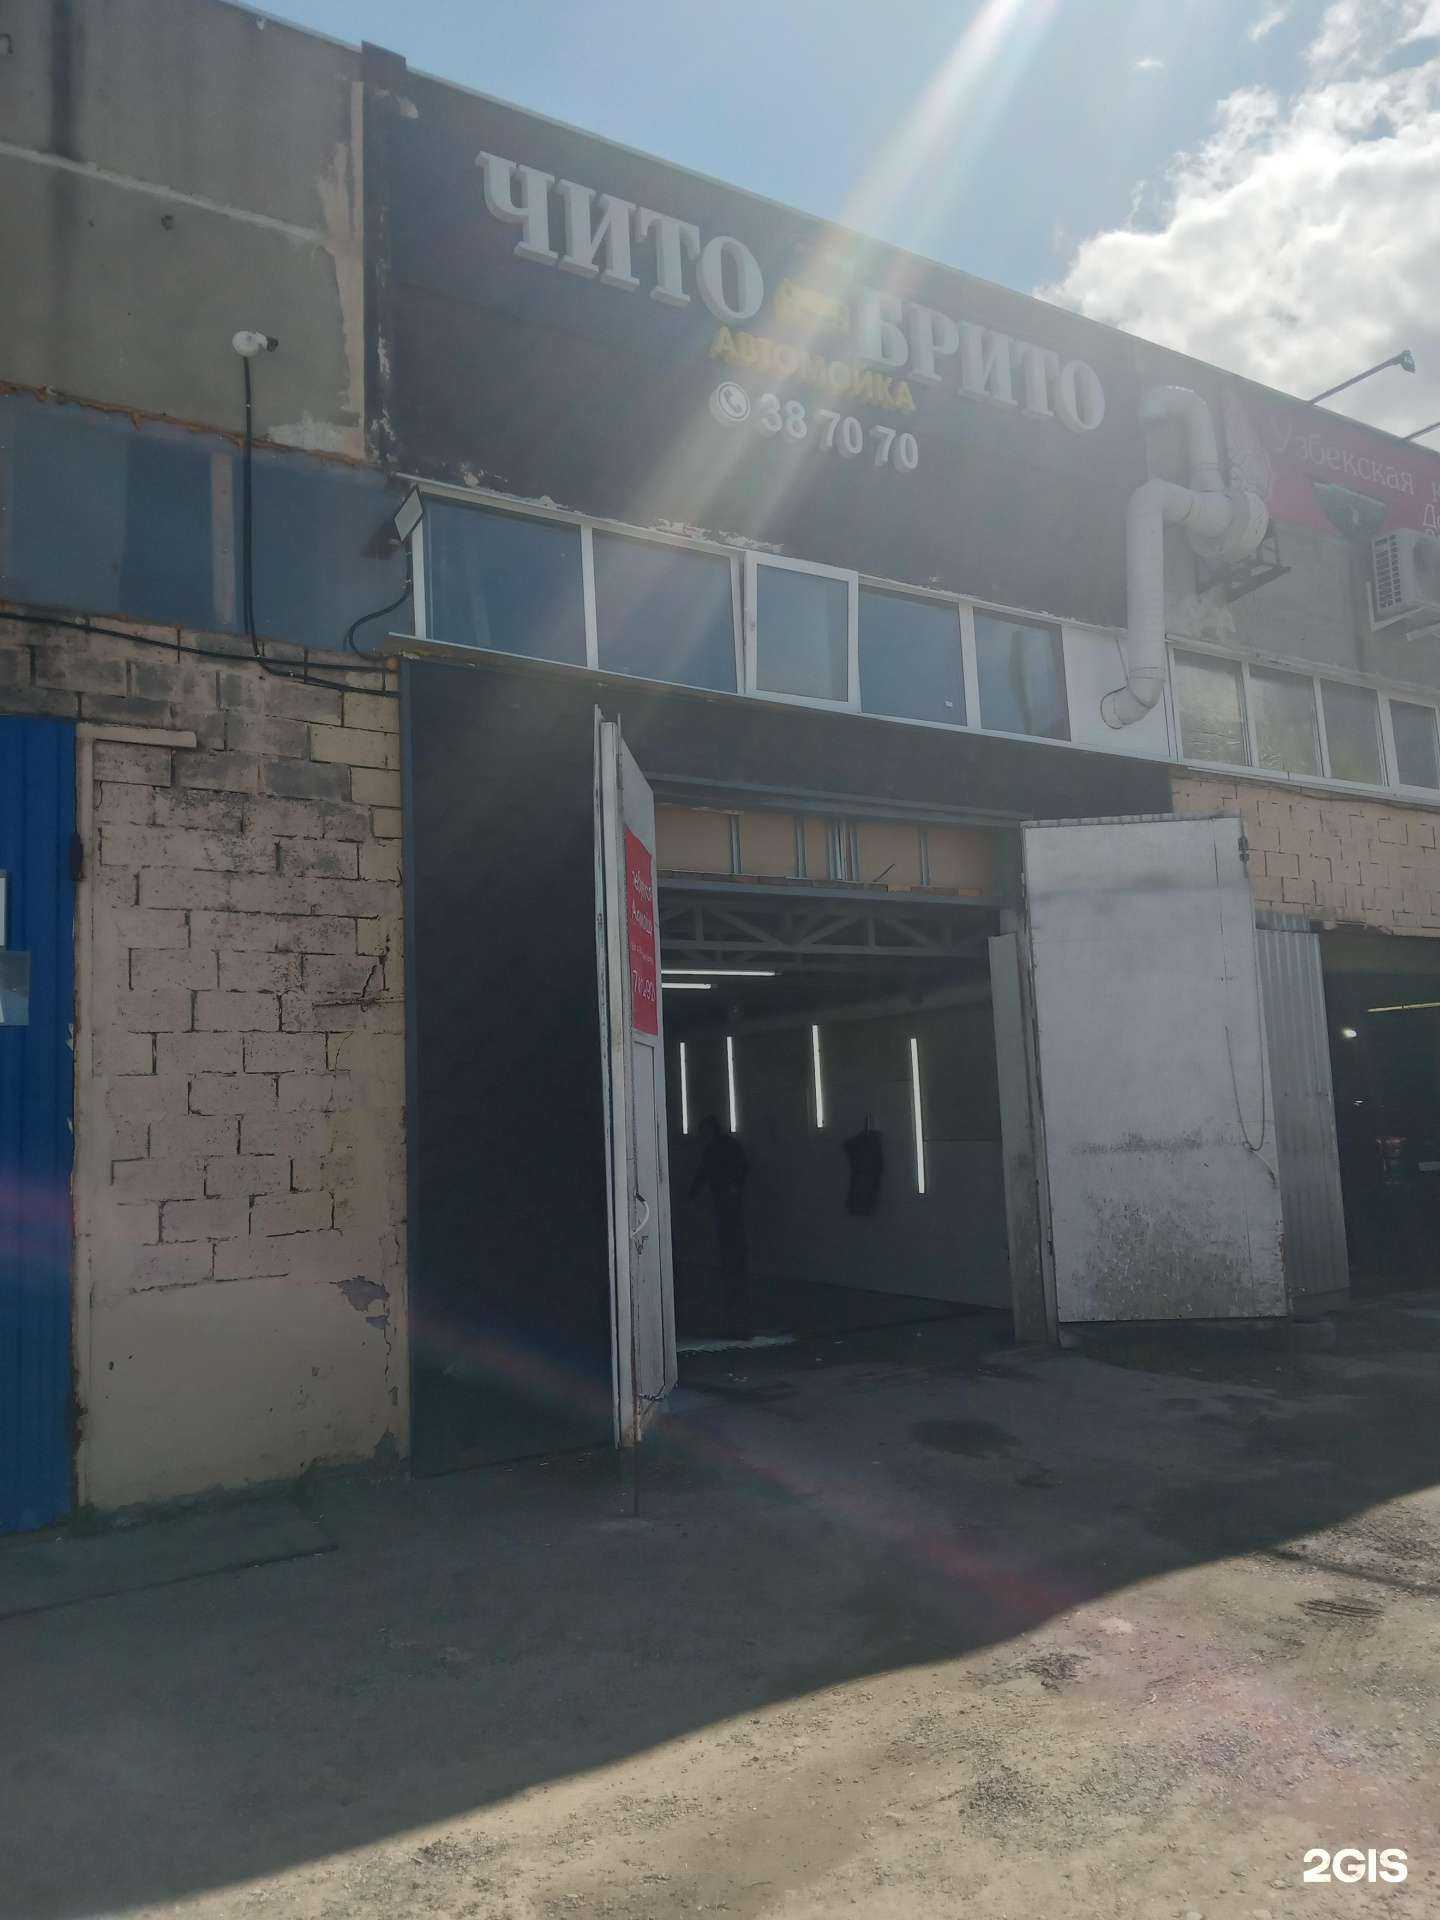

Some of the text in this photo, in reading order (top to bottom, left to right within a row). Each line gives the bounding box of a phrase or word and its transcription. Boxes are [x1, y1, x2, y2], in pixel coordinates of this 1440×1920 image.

[474, 151, 1106, 433] ЧИТО БРИТО
[757, 392, 919, 473] 38 70 70
[1270, 416, 1416, 496] Узбекская
